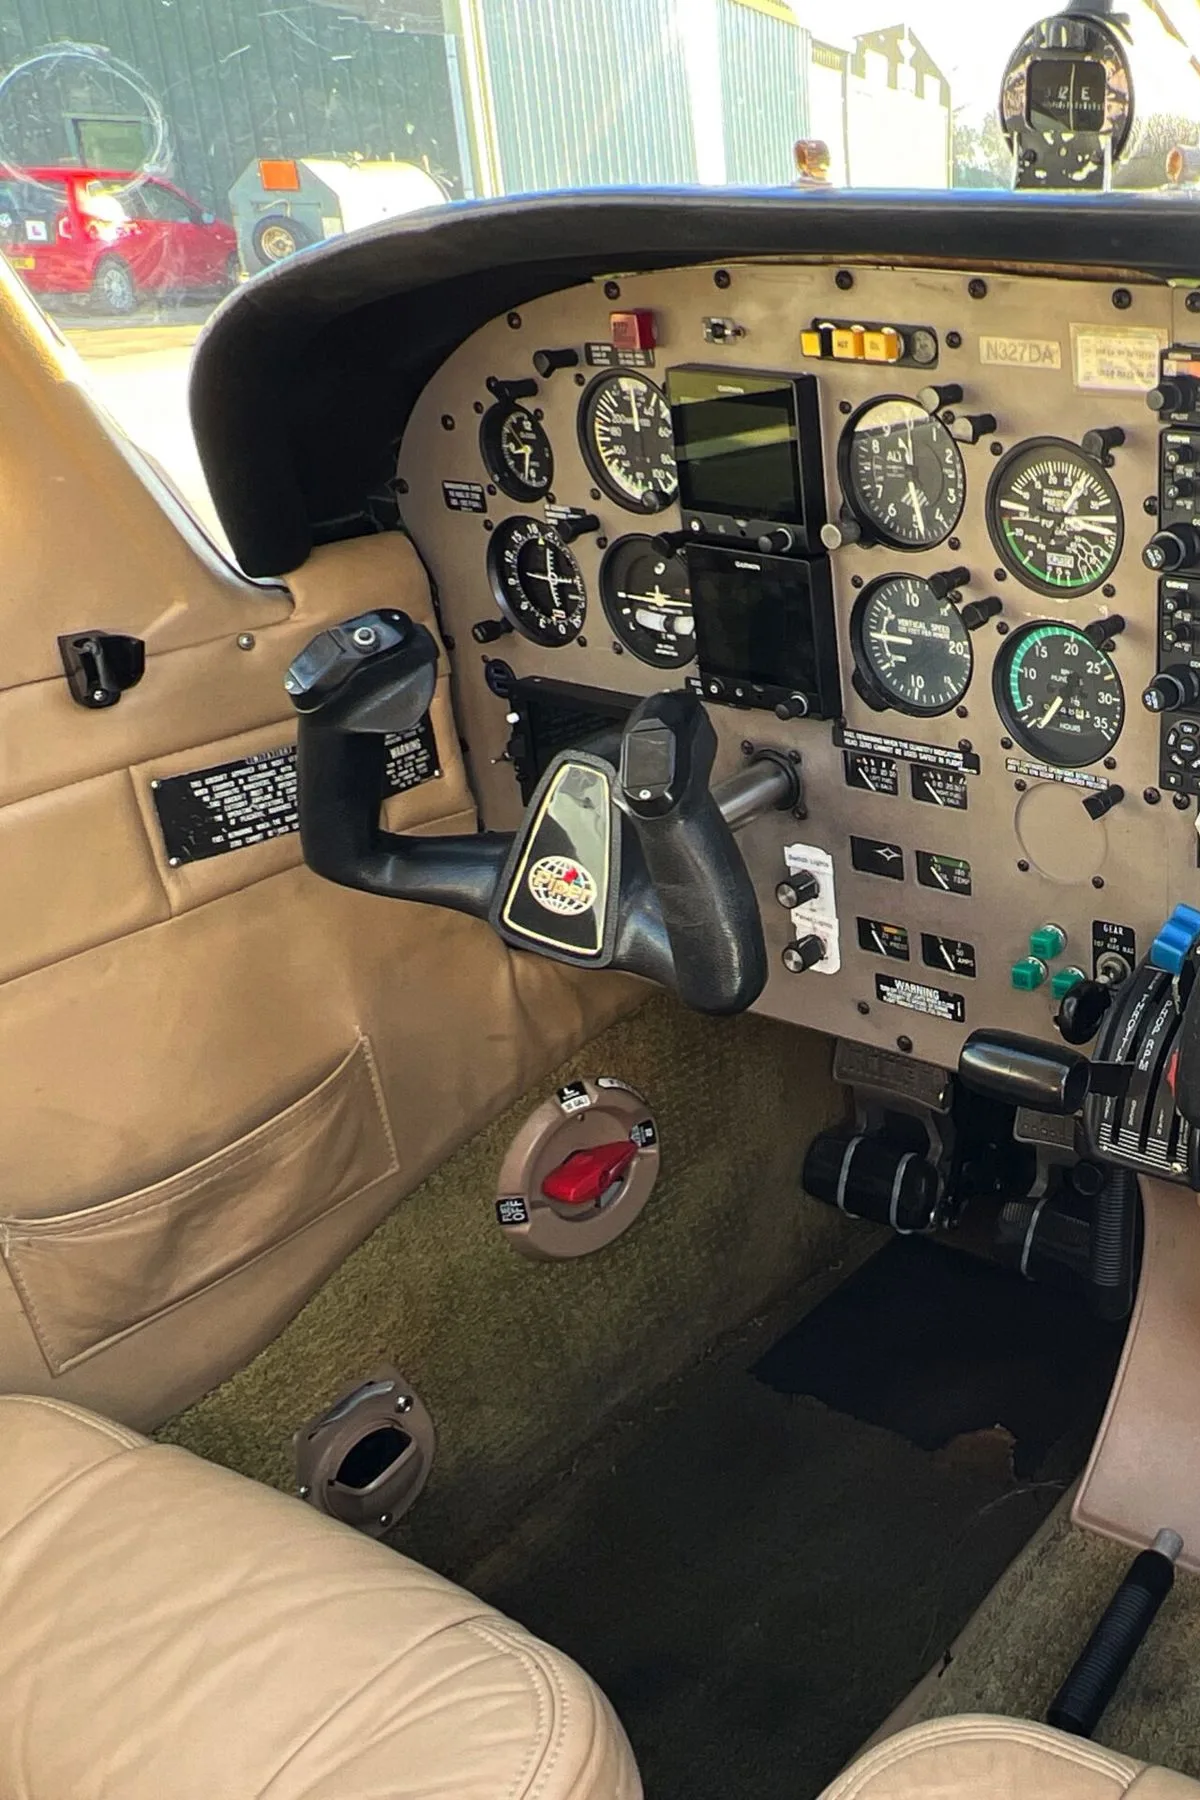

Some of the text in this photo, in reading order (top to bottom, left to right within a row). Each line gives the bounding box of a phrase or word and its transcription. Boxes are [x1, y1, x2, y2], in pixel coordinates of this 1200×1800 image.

[986, 340, 1055, 364] N327DA
[881, 424, 892, 438] 9
[871, 439, 880, 454] 8
[945, 448, 954, 464] 2
[875, 484, 884, 499] 7
[947, 487, 956, 504] 3
[887, 502, 897, 518] 6
[934, 507, 944, 522] 4
[905, 592, 920, 608] 10
[930, 623, 951, 634] SPEED
[948, 640, 964, 655] 20
[1034, 644, 1049, 659] 15
[1063, 642, 1079, 656] 20
[1023, 667, 1037, 680] 10
[1085, 660, 1102, 676] 25
[910, 674, 925, 689] 10
[1025, 694, 1034, 708] 5
[1097, 692, 1113, 705] 30
[1059, 722, 1081, 733] HOURS
[1093, 716, 1109, 730] 35
[533, 868, 593, 904] Piper
[952, 875, 971, 886] TEMP
[1102, 923, 1125, 936] GEAR
[957, 958, 975, 967] AMPS
[894, 978, 940, 1001] WARNING
[1138, 999, 1173, 1072] PROP RPM
[501, 1200, 513, 1222] FUEL
[512, 1199, 526, 1222] OFF
